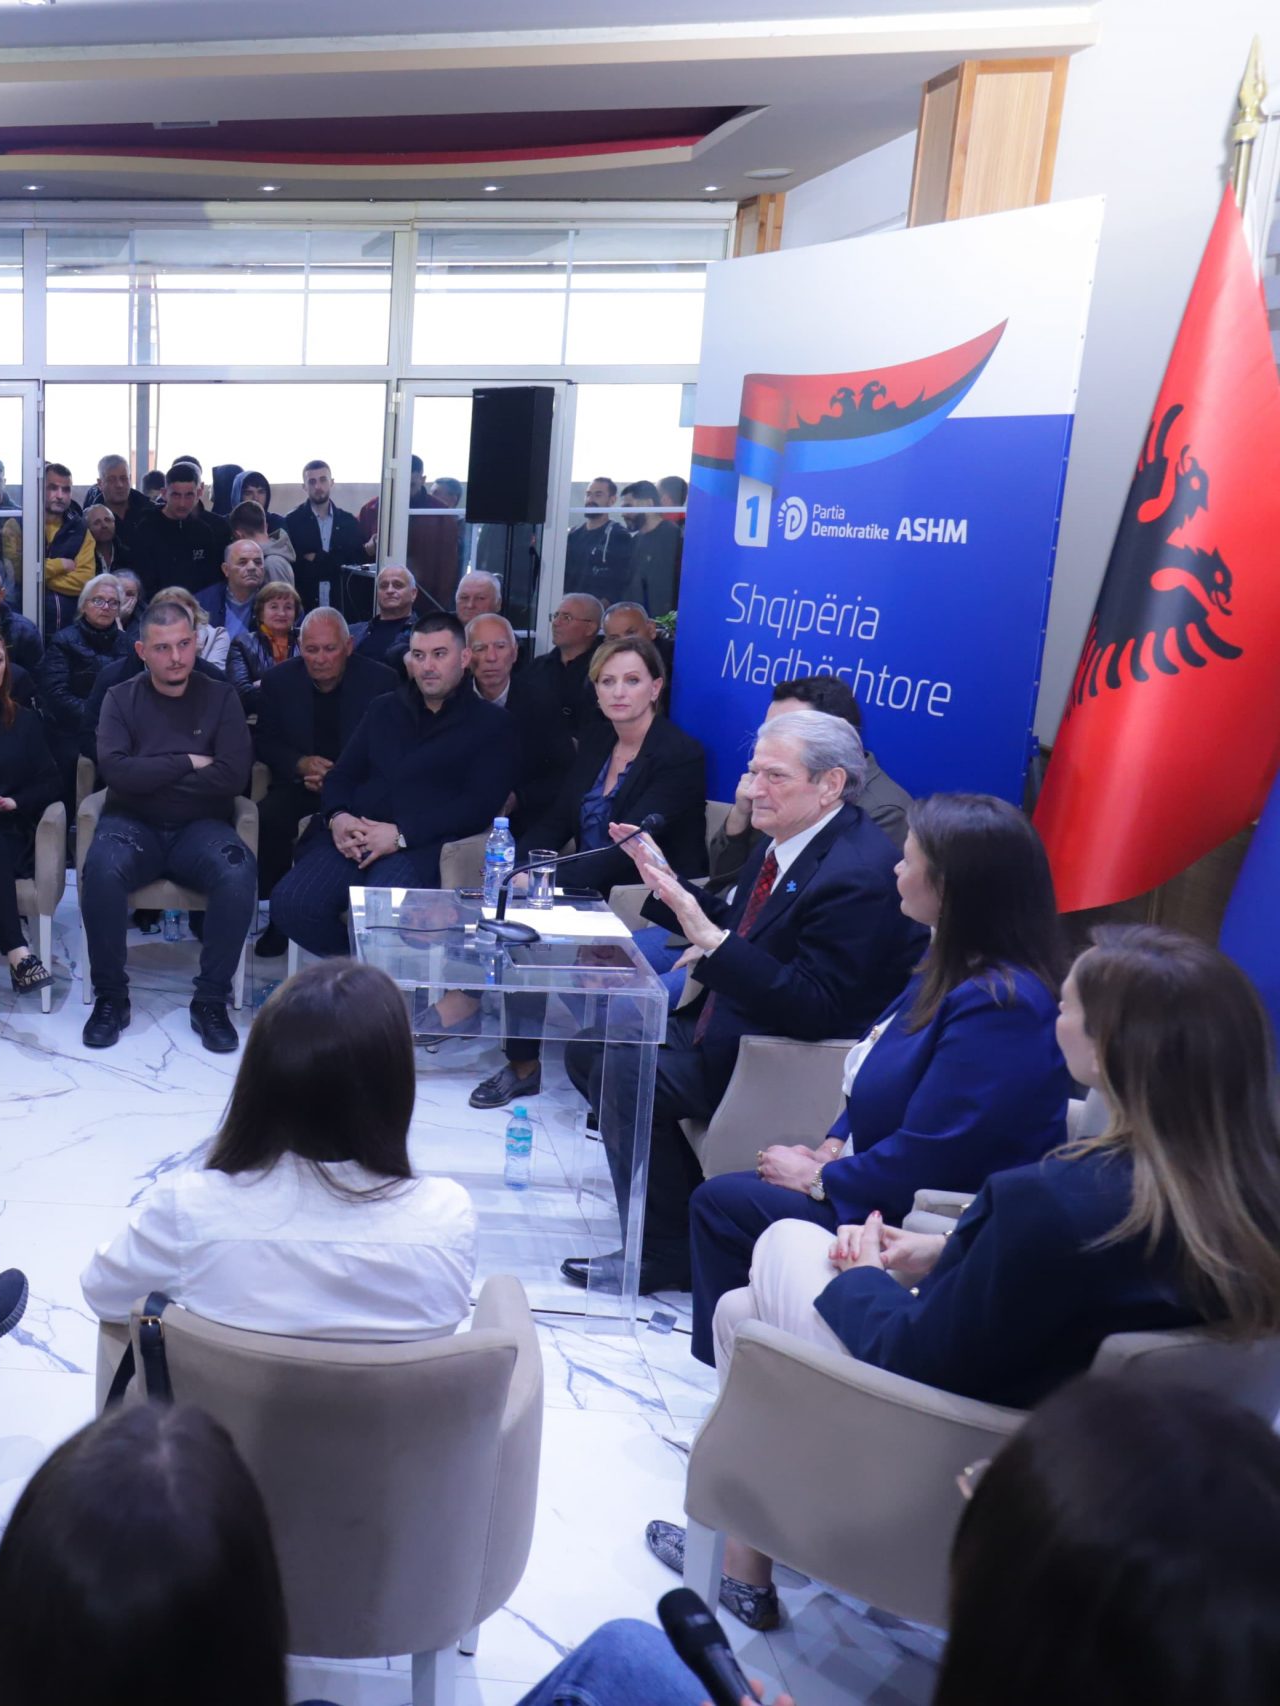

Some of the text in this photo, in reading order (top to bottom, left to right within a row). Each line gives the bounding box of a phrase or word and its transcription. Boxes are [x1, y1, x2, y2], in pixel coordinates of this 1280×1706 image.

[746, 496, 760, 539] 1
[812, 504, 846, 521] Partia
[811, 521, 890, 541] Demokratike
[895, 517, 968, 544] ASHM
[725, 582, 880, 641] Shqipëria
